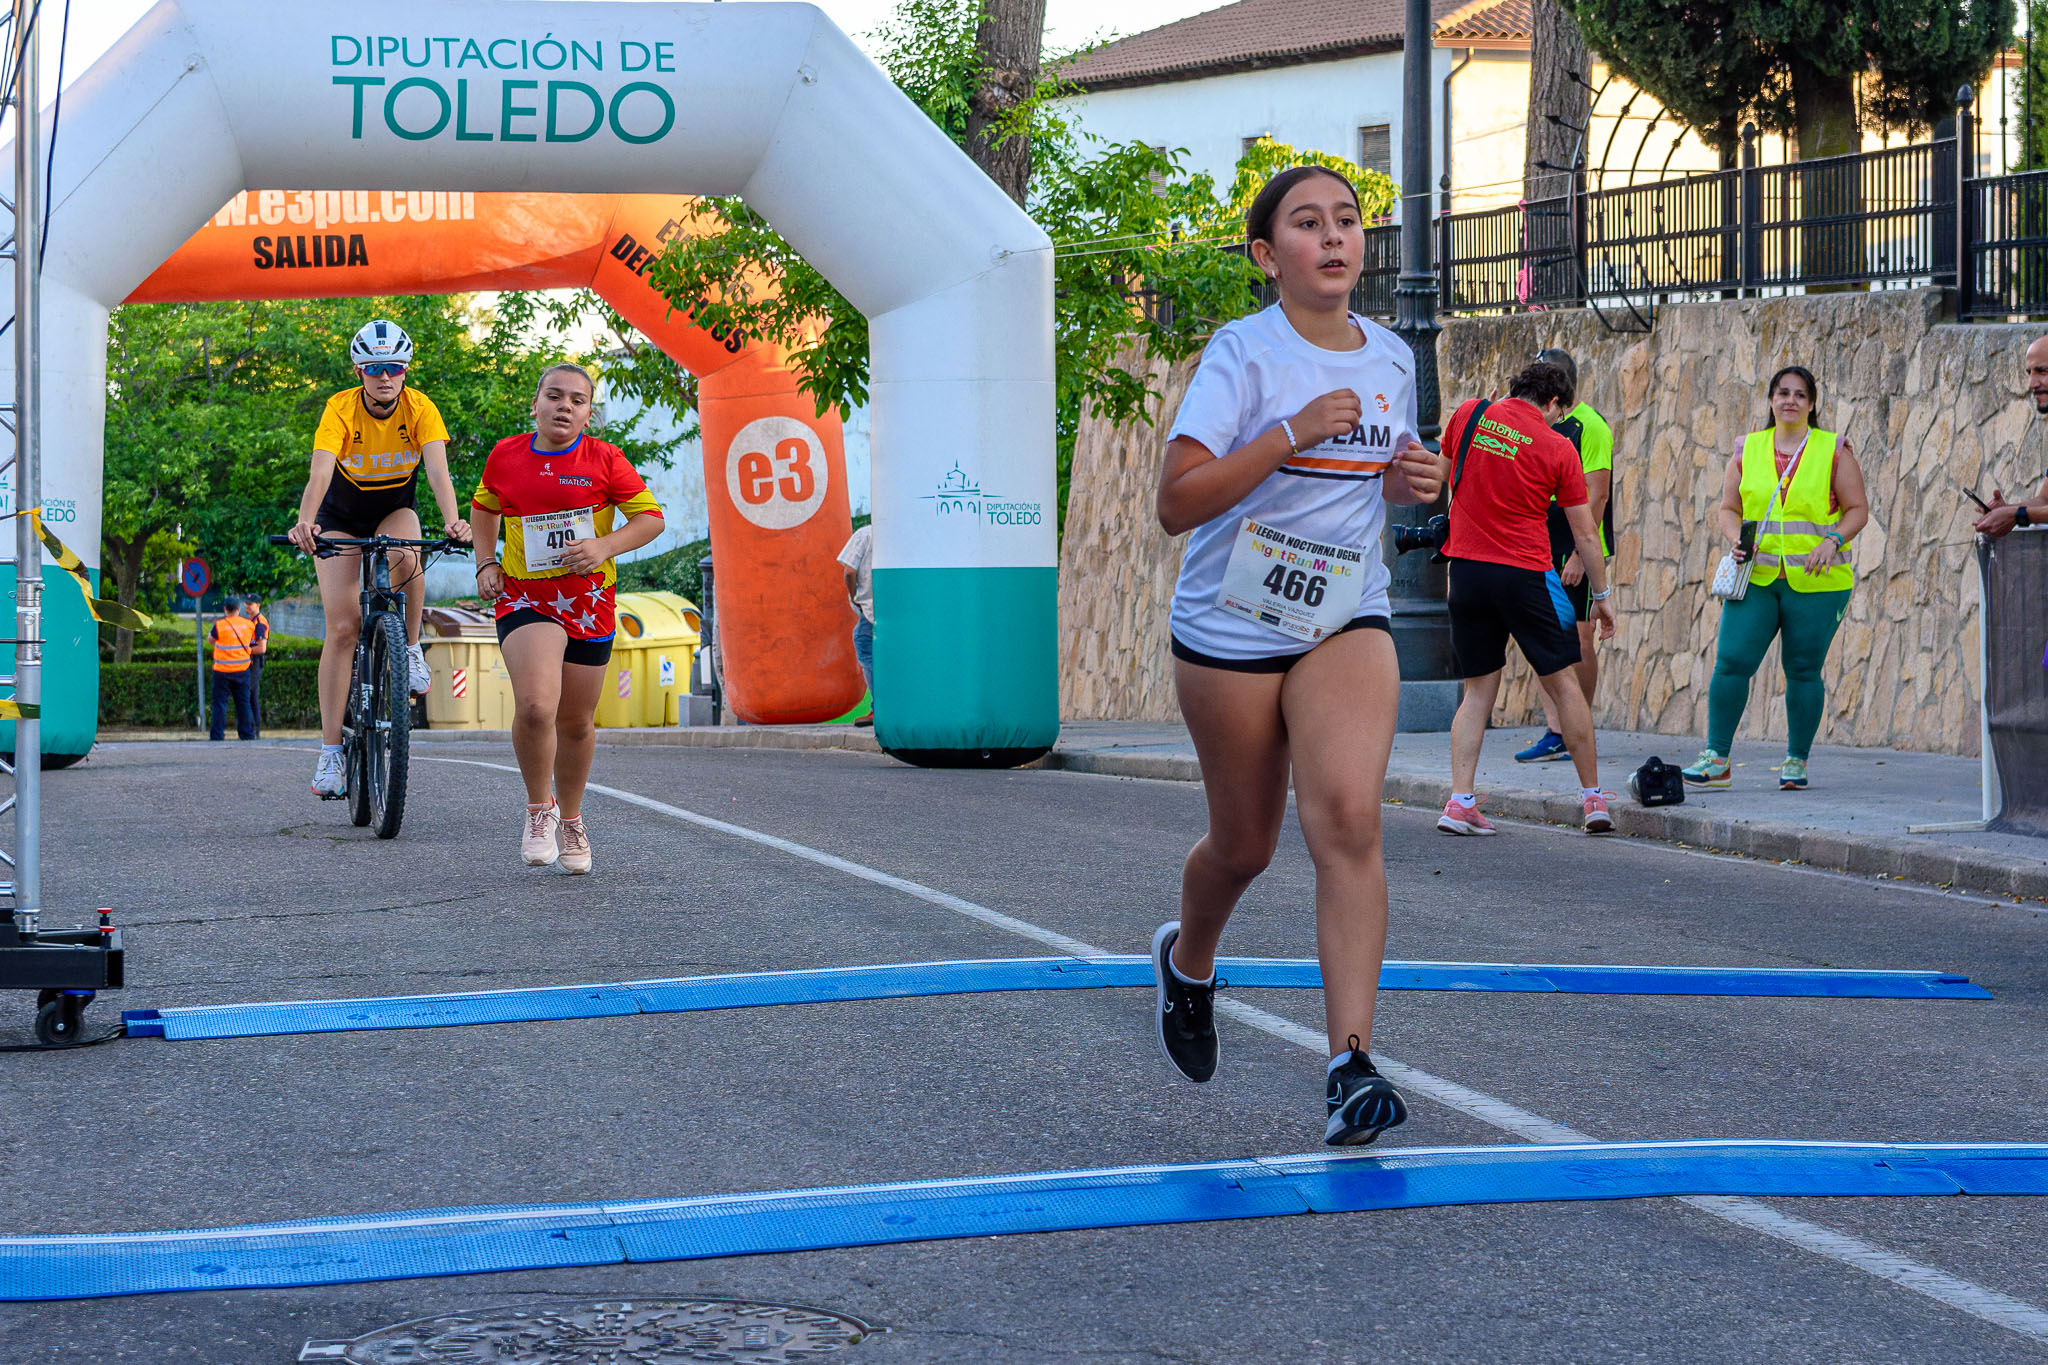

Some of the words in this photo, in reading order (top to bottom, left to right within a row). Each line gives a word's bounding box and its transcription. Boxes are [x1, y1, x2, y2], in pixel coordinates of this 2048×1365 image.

[331, 32, 603, 71] DIPUTACIÓN
[620, 41, 676, 72] DE
[332, 75, 676, 145] TOLEDO
[253, 234, 369, 269] SALIDA
[370, 450, 421, 469] TEAM
[737, 437, 815, 505] e3
[986, 502, 1033, 511] DIPUTACIÓN
[987, 512, 1041, 525] TOLEDO
[1256, 525, 1285, 543] LEGUA
[1285, 535, 1336, 558] NOCTURNA
[1263, 563, 1328, 607] 466
